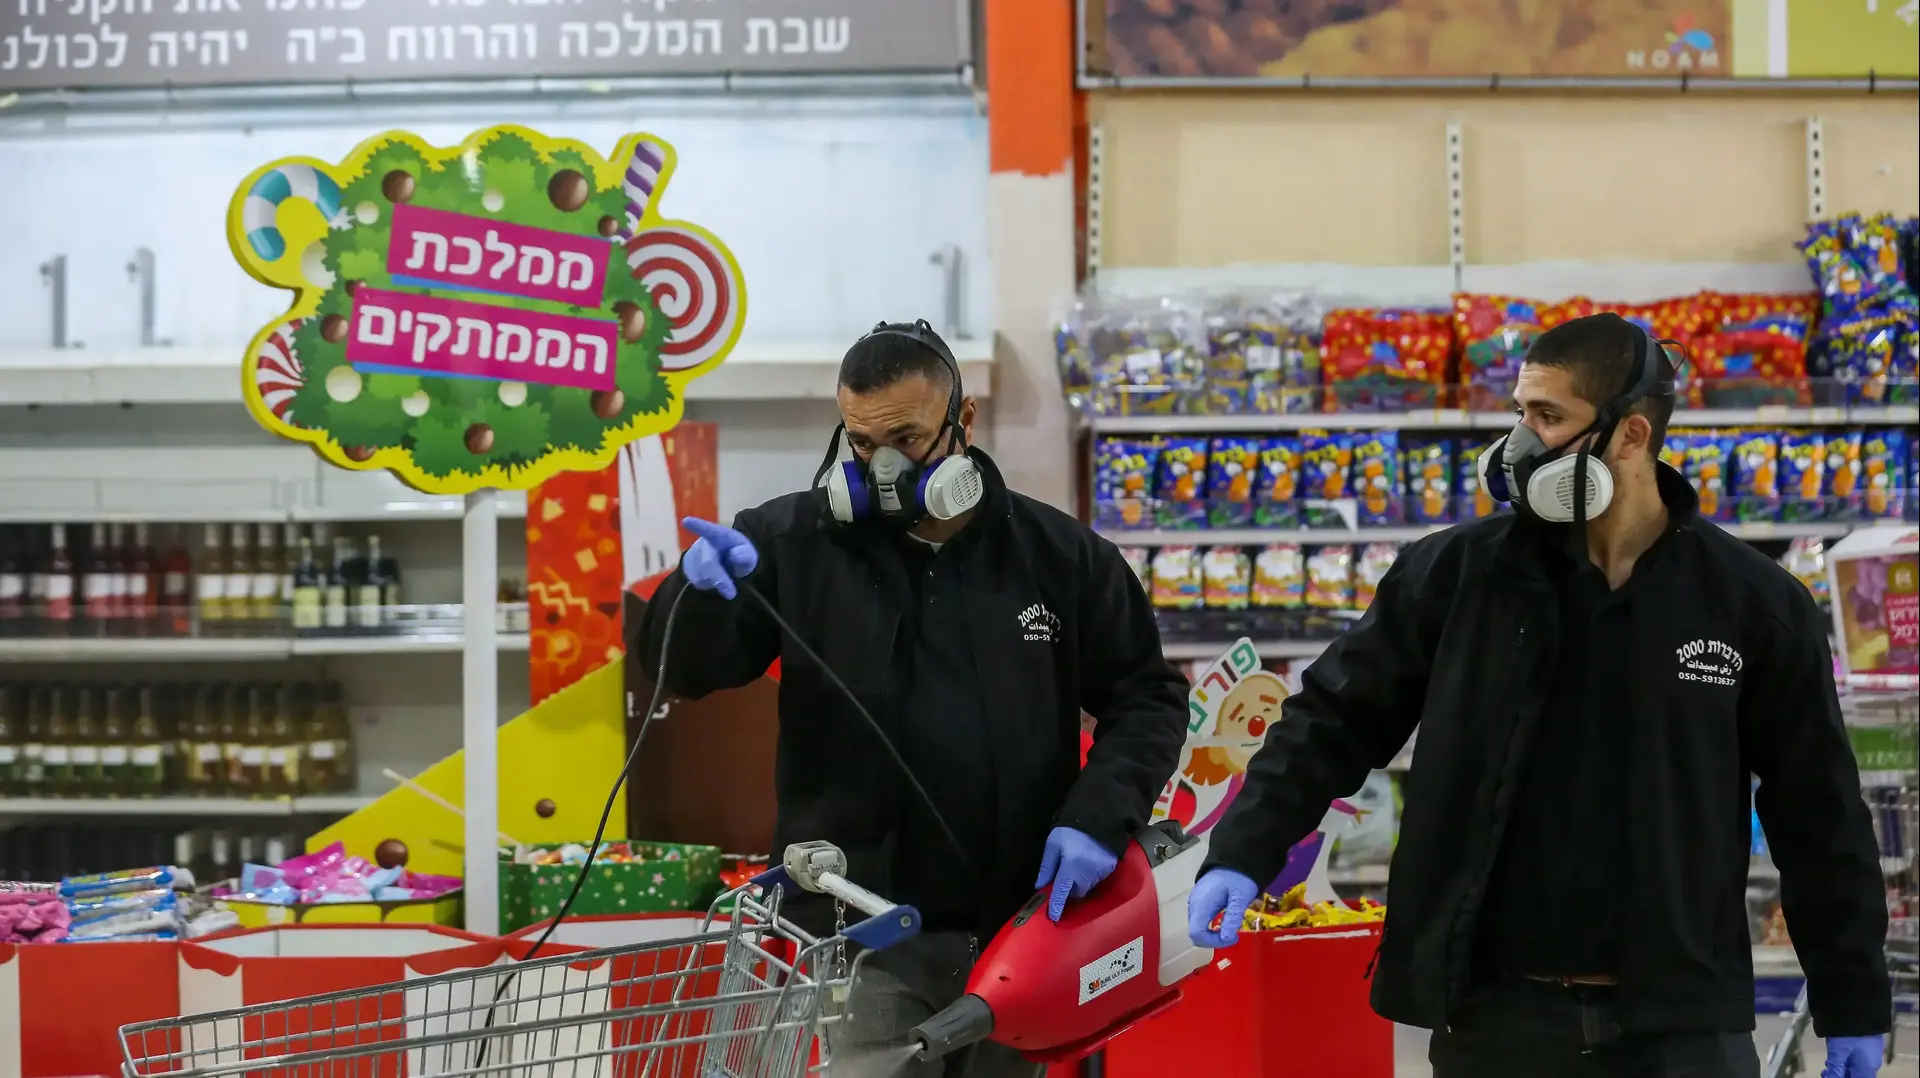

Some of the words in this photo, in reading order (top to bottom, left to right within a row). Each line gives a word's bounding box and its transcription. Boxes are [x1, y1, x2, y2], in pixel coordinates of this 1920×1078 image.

[149, 29, 248, 67] יהיה
[386, 23, 537, 62] והרווח
[559, 12, 722, 57] המלכה
[744, 16, 850, 55] שבת
[1626, 50, 1719, 68] NOAM
[406, 229, 595, 291] ממלכת
[357, 304, 608, 374] הממתקים
[1018, 604, 1040, 627] 2000
[1676, 639, 1704, 663] 2000
[1707, 640, 1743, 671] הדברות
